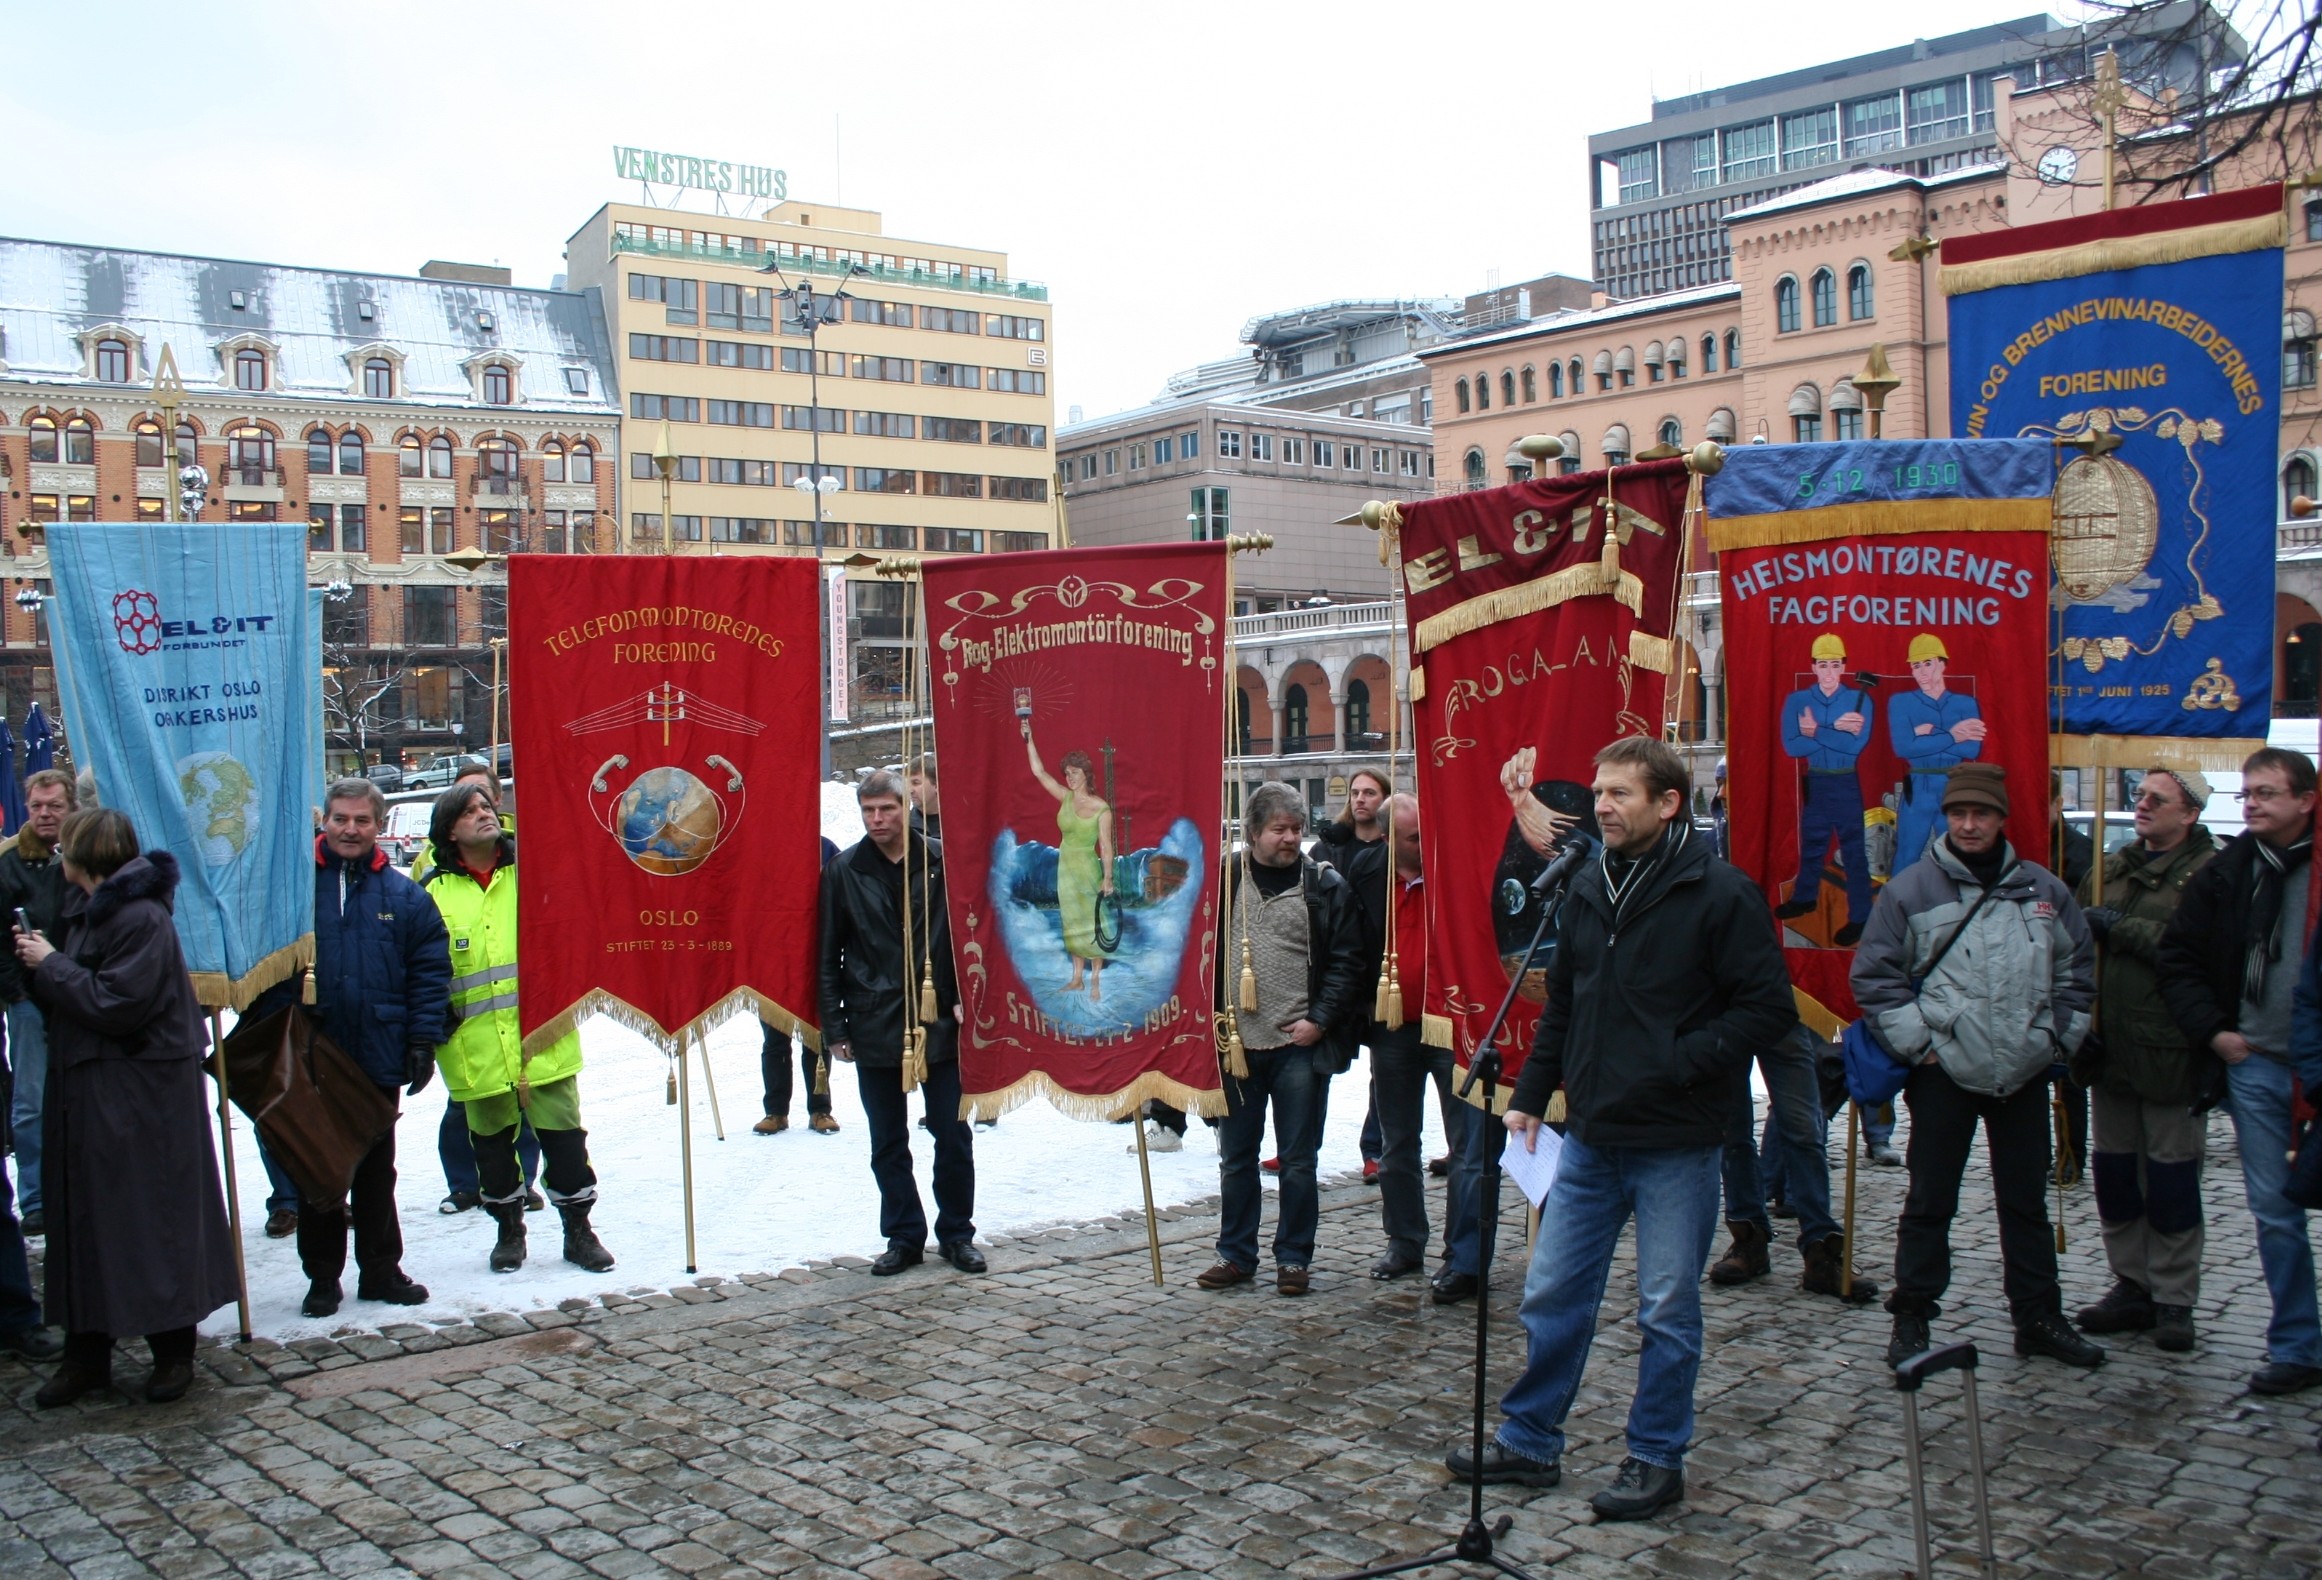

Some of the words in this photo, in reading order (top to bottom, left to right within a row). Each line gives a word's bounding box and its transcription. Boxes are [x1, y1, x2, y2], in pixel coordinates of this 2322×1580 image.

[613, 145, 732, 193] VENSTRES
[740, 164, 788, 201] HUS
[2003, 297, 2264, 416] BRENNEVINARBEIDERNES
[2040, 363, 2168, 399] FORENING
[1895, 462, 1958, 488] 1930
[1731, 543, 2034, 601] HEISMONTØRENES
[1769, 594, 2000, 626] FAGFORENING
[163, 639, 246, 651] FORBUNDET
[543, 605, 785, 658] TELEFONMONTØRENES
[836, 583, 845, 709] YOUNGSTORGET
[613, 642, 717, 664] FORENING
[222, 680, 261, 698] OSLO
[2098, 686, 2132, 698] JUNI
[2140, 684, 2170, 696] 1925
[640, 909, 699, 926] OSLO
[606, 940, 656, 953] STIFTET
